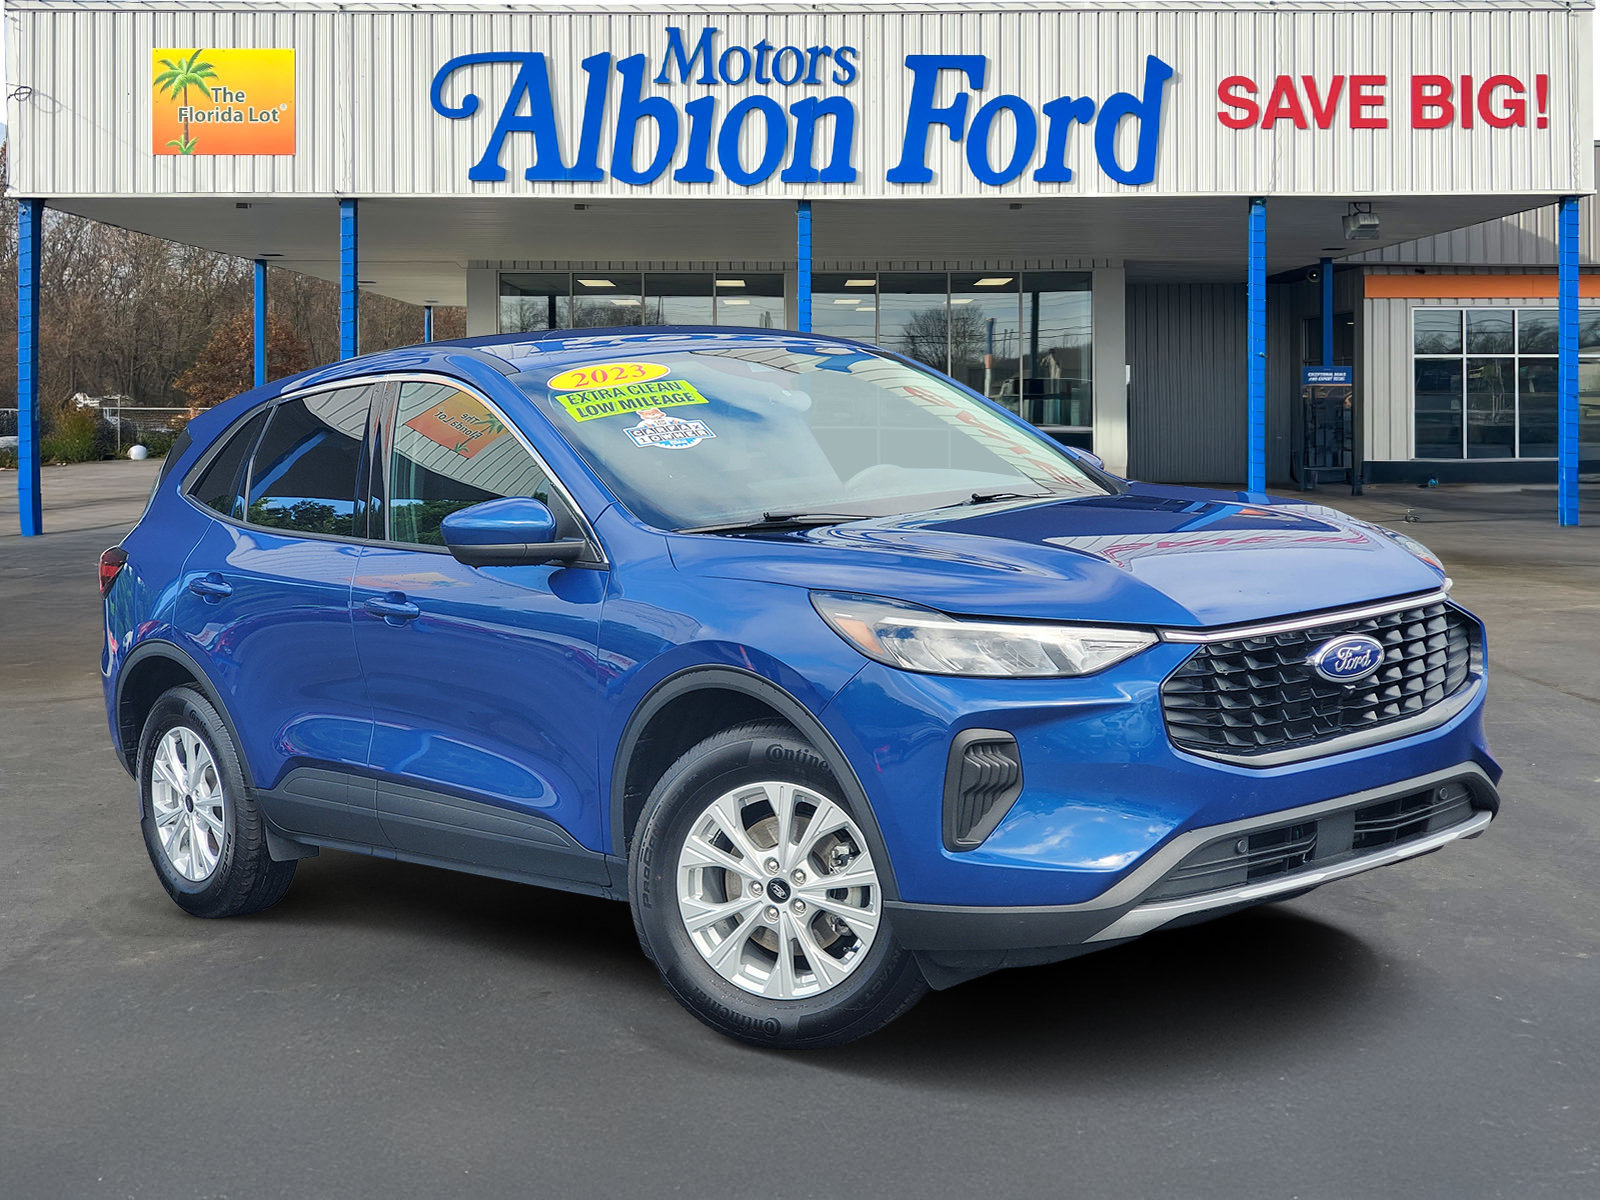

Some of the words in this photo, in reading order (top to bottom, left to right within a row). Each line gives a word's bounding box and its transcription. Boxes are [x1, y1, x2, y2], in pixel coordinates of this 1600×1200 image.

[653, 26, 858, 85] Motors
[211, 86, 246, 103] The
[1216, 74, 1388, 130] SAVE
[1411, 73, 1549, 130] BIG!
[178, 106, 244, 123] Florida
[248, 106, 280, 123] Lot
[430, 51, 857, 187] Albion
[886, 53, 1174, 186] Ford
[571, 364, 647, 388] 2023
[566, 387, 626, 405] EXTRA
[627, 381, 682, 398] CLEAN
[576, 402, 615, 418] LOW
[616, 392, 695, 411] MILEAGE
[1334, 645, 1372, 672] Ford
